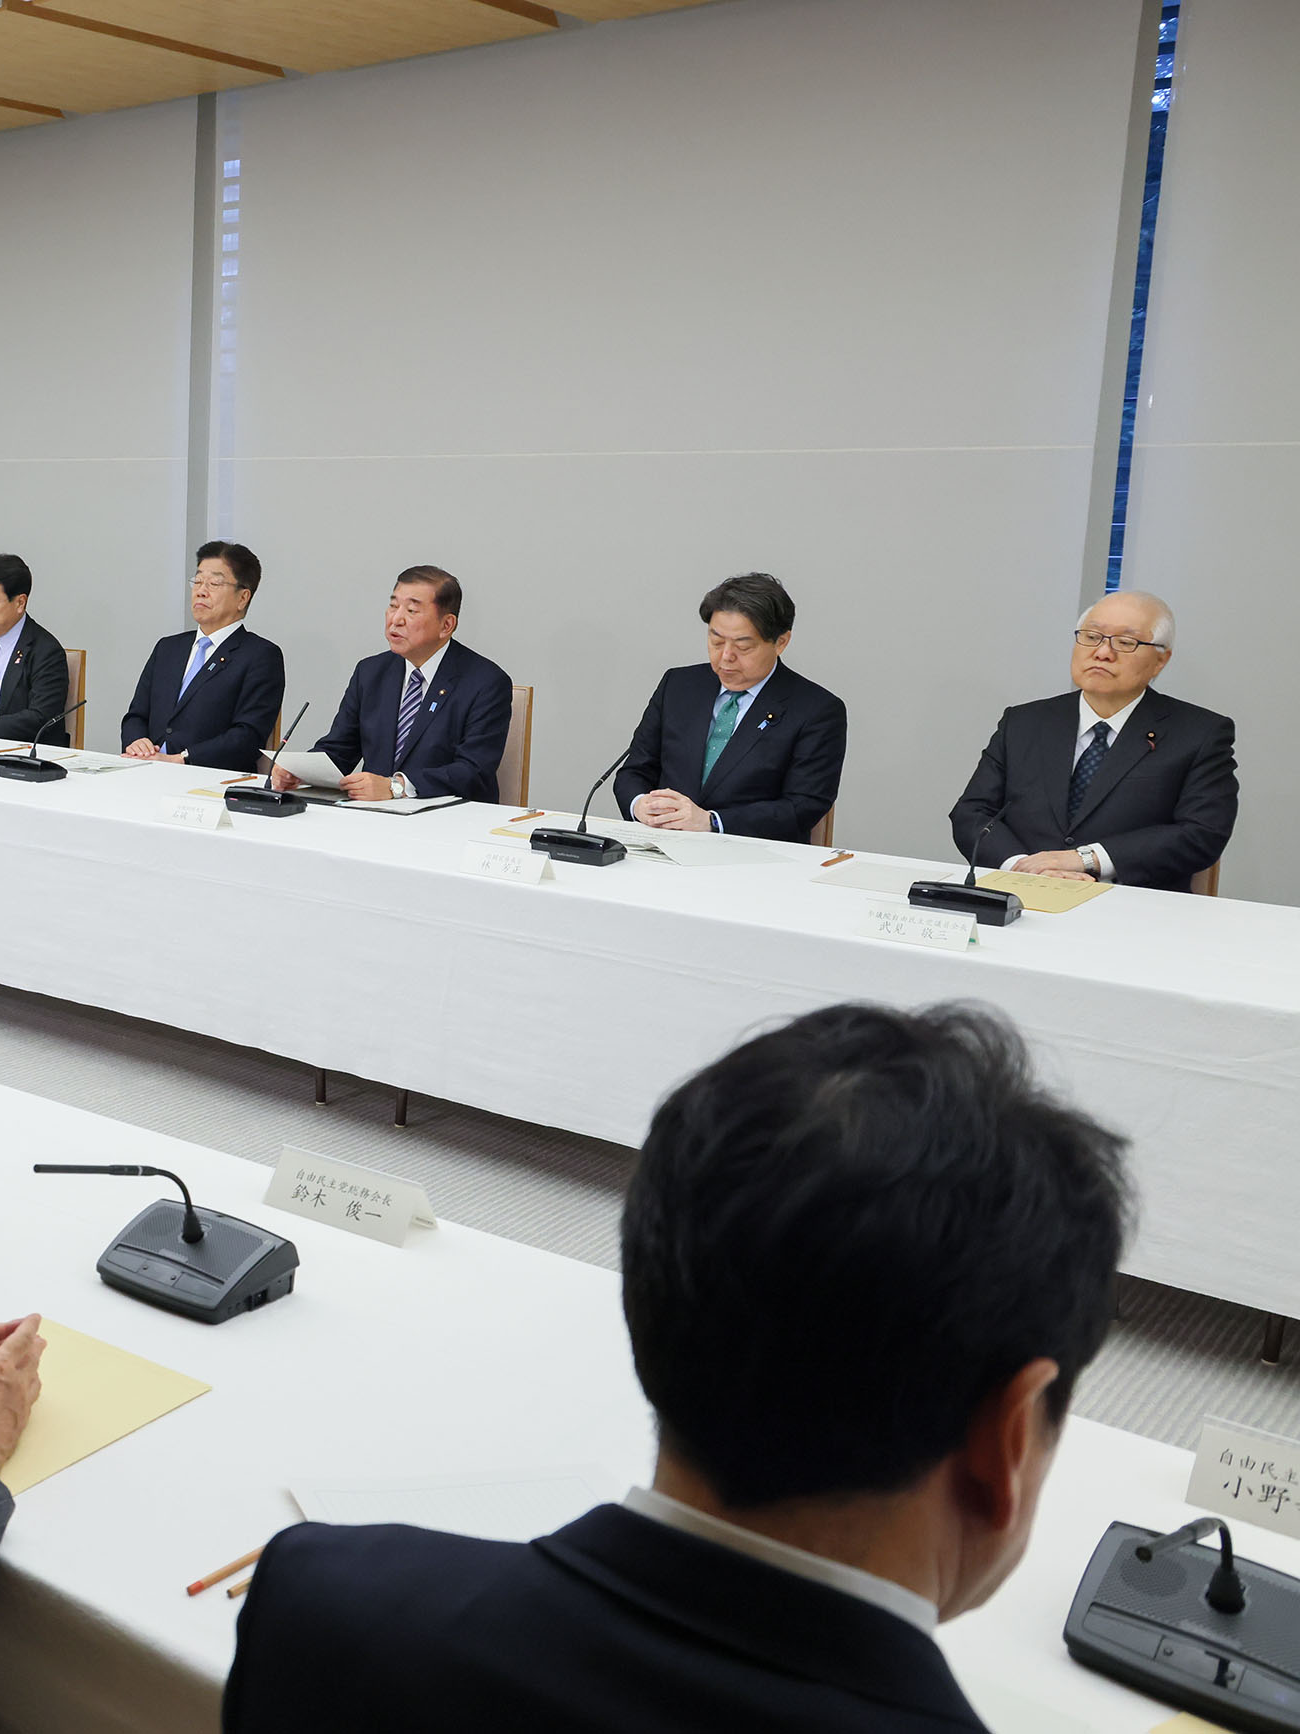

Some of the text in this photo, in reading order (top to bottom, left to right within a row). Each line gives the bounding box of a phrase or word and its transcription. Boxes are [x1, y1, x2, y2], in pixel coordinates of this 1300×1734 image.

[878, 920, 948, 941] 武見 敬三
[291, 1183, 382, 1222] 鈴木 俊一
[295, 1168, 393, 1207] 自由民主党総務会長
[1219, 1448, 1300, 1485] 自由民主
[1223, 1475, 1300, 1514] 小野
